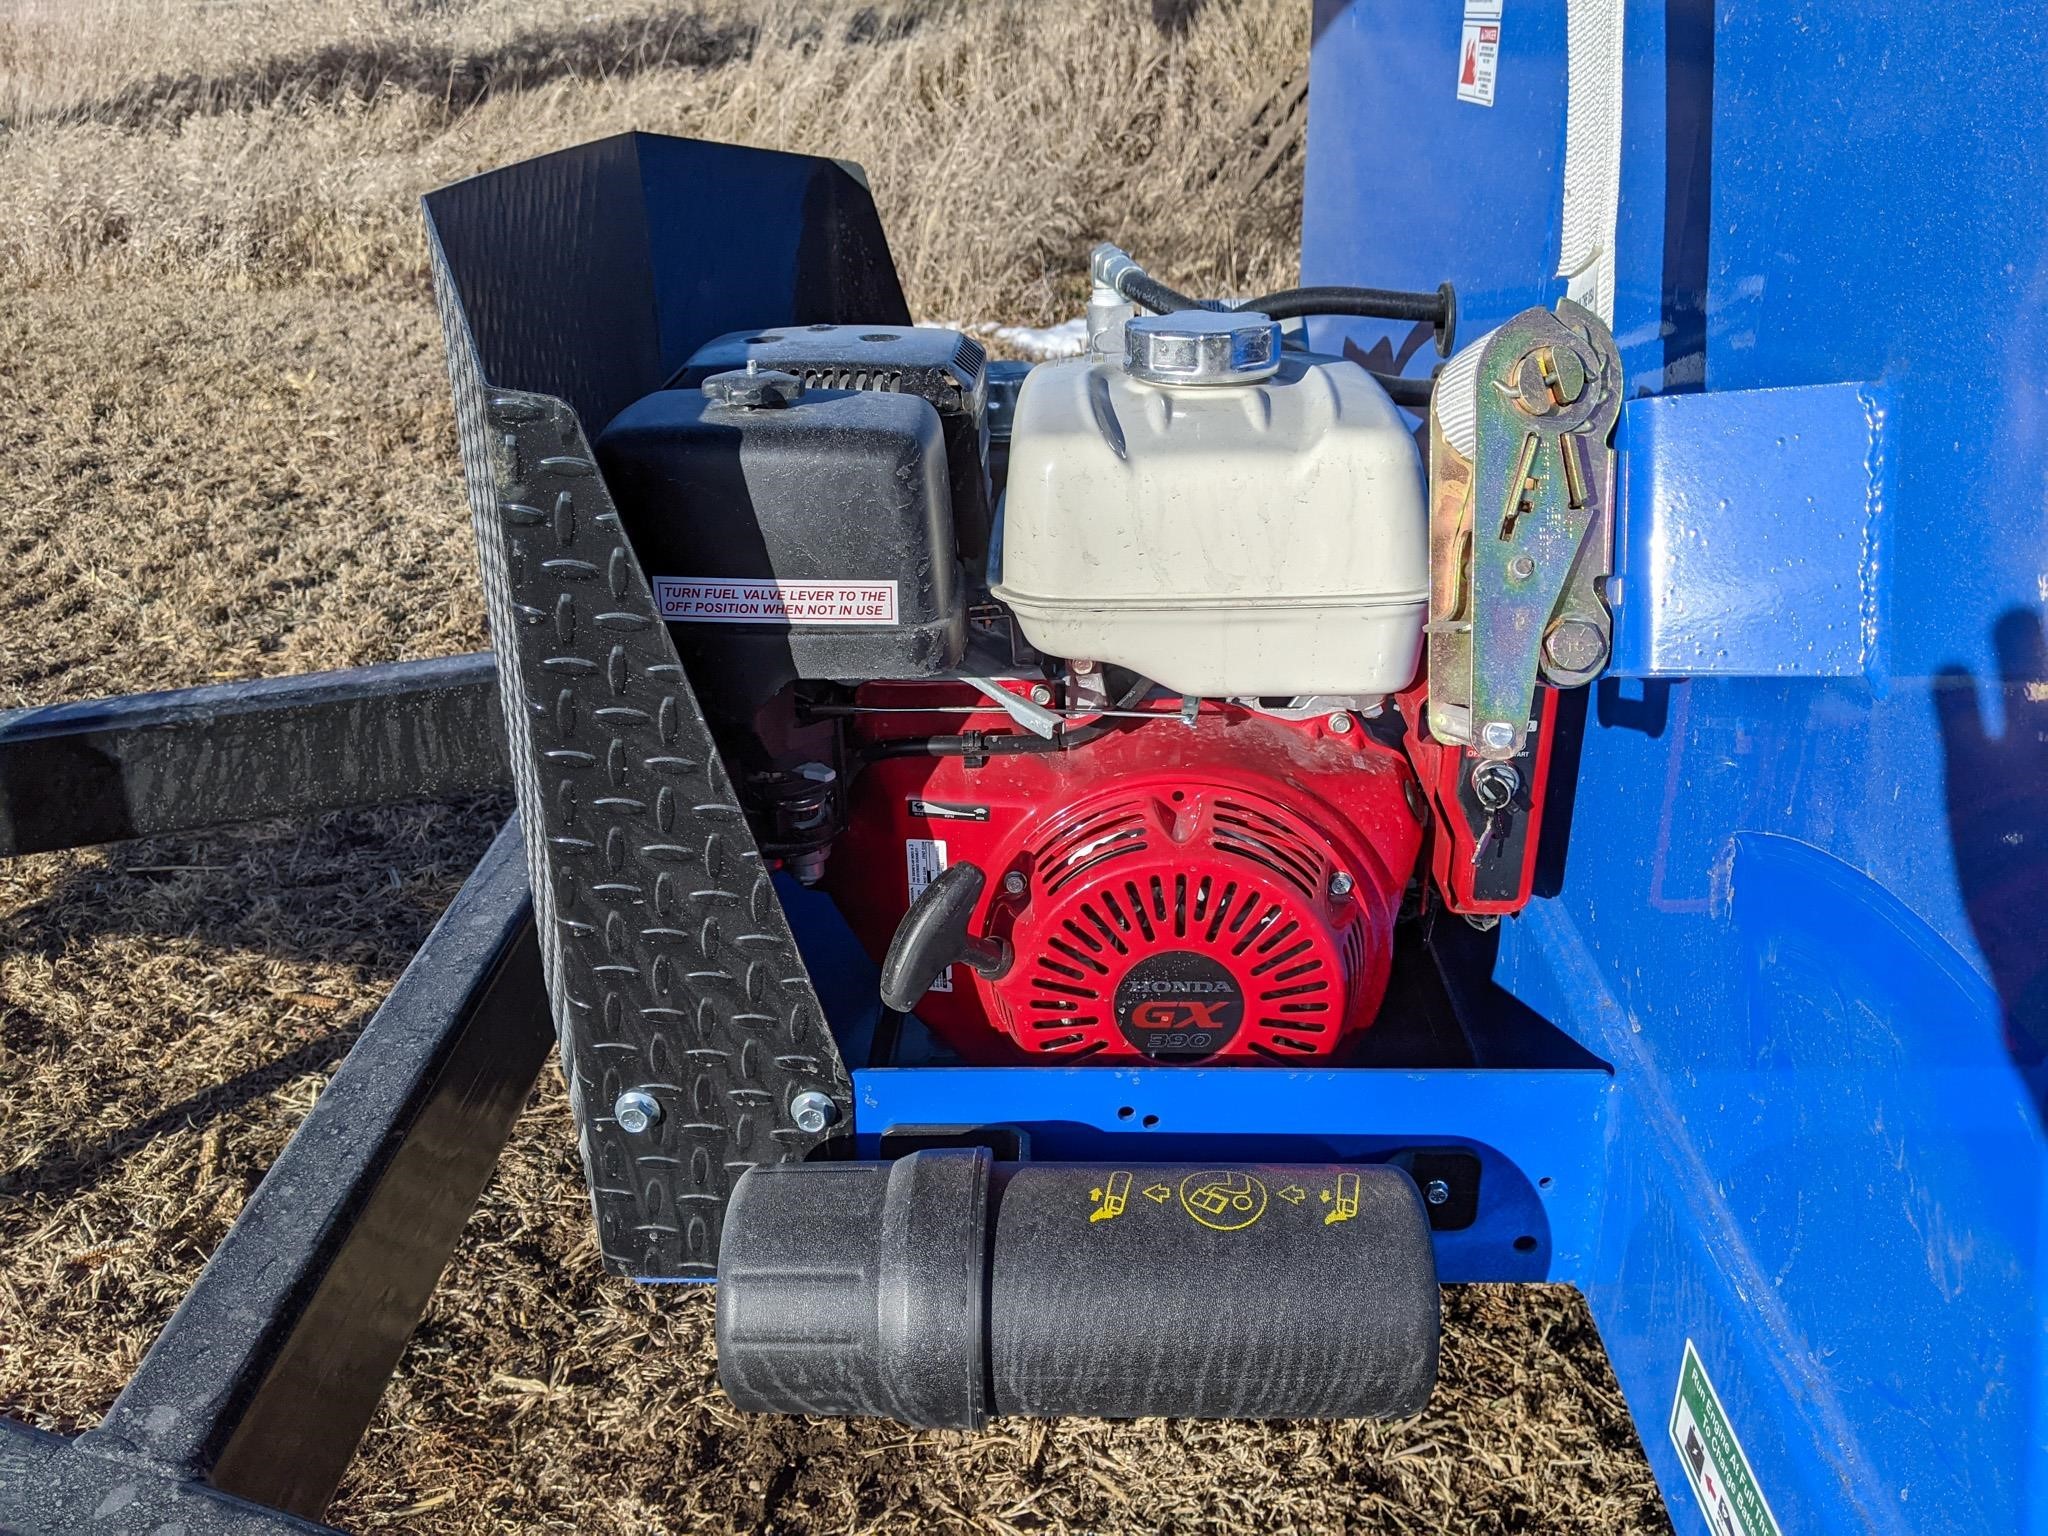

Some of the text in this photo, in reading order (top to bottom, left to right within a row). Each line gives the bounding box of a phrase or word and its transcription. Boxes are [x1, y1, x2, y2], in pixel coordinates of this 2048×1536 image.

[664, 586, 887, 602] TURN FUEL VALVE LEVER TO THE
[665, 602, 884, 616] OFF POSITION WHEN NOT IN USE
[1128, 980, 1235, 993] HONDA
[1131, 1001, 1231, 1029] GX
[1147, 1033, 1212, 1048] 390
[1691, 1367, 1706, 1403] Run
[1705, 1398, 1731, 1453] Engine
[1729, 1454, 1740, 1476] At
[1739, 1471, 1755, 1508] Full
[1702, 1414, 1711, 1438] To
[1711, 1437, 1737, 1494] Charge
